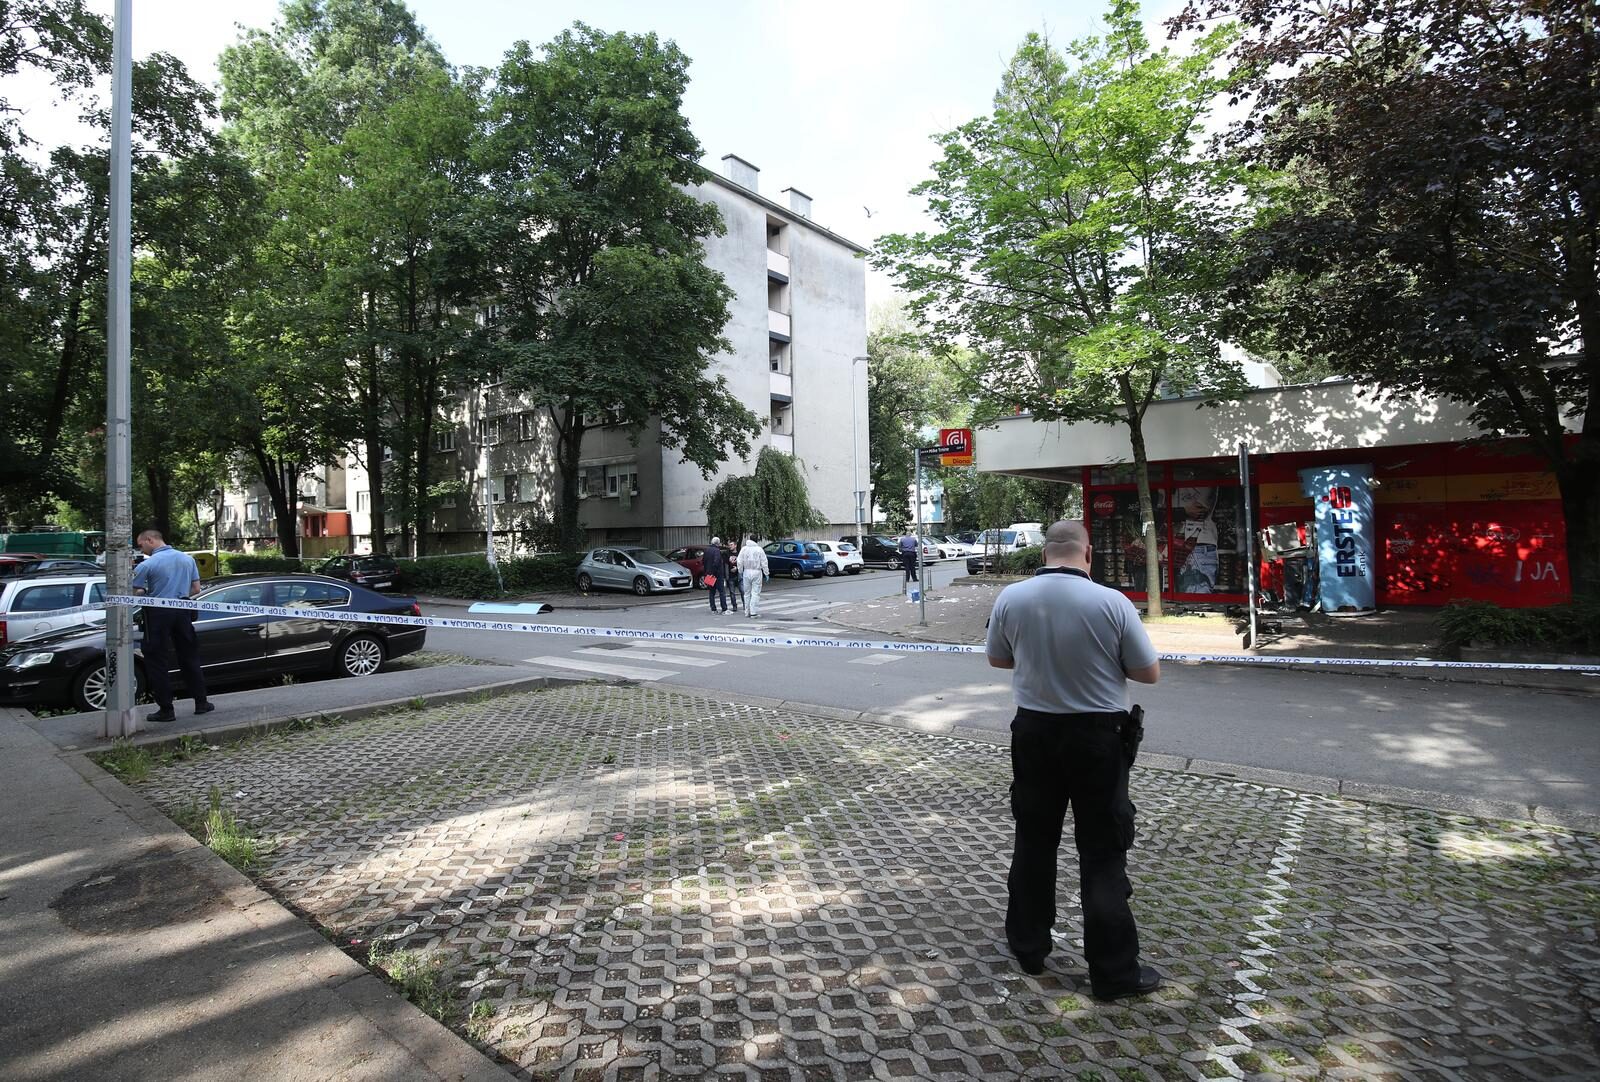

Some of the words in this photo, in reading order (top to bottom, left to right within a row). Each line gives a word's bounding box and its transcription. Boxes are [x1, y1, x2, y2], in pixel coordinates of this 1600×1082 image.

[1332, 512, 1356, 577] ERSTE
[1358, 551, 1366, 577] Bank
[167, 600, 198, 608] POLICIJA
[233, 605, 264, 614] POLICIJA
[301, 610, 335, 619] POLICIJA
[374, 615, 409, 624] POLICIJA
[450, 620, 487, 629] POLICIJA
[530, 625, 569, 633] POLICIJA
